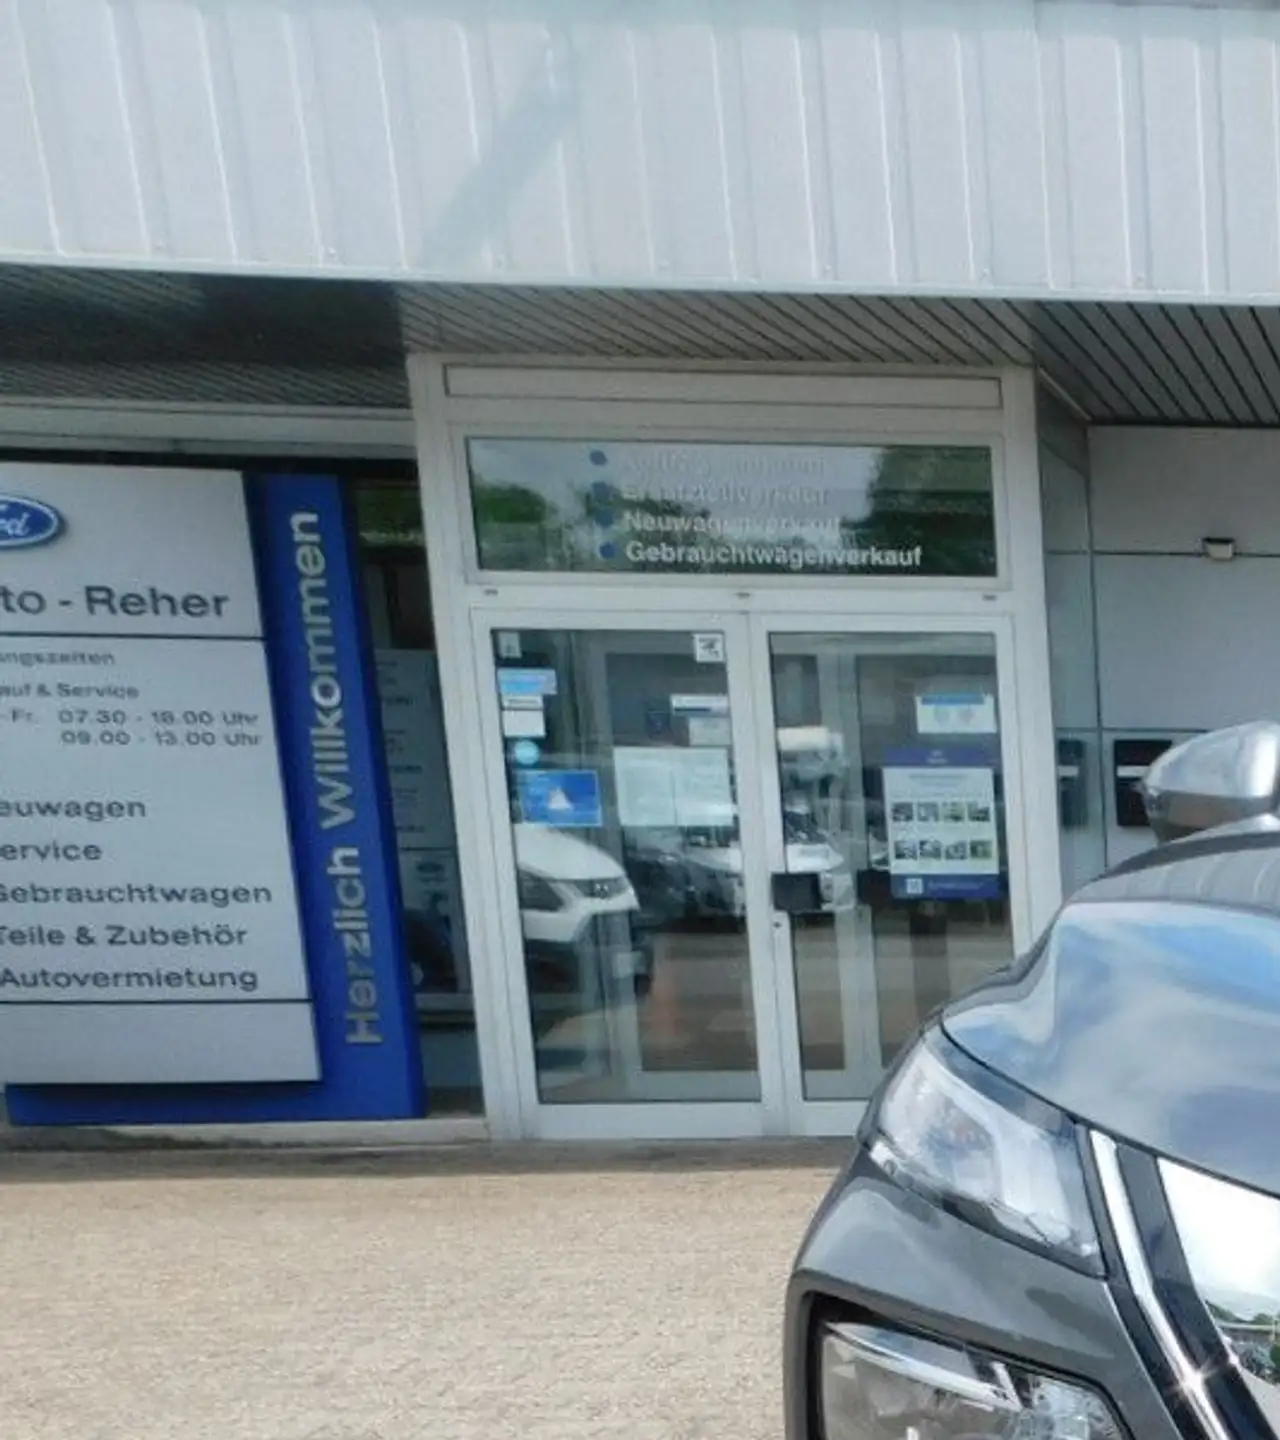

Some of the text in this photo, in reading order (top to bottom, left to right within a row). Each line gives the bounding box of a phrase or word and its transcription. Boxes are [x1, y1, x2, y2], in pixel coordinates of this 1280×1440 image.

[625, 540, 923, 569] Gebrauchtwagenverkauf
[84, 585, 229, 617] Reher
[289, 511, 384, 1046] Herzlich Willkommen
[75, 926, 96, 947] &
[104, 923, 248, 947] Zubehör
[1, 966, 259, 992] Autovermietung
